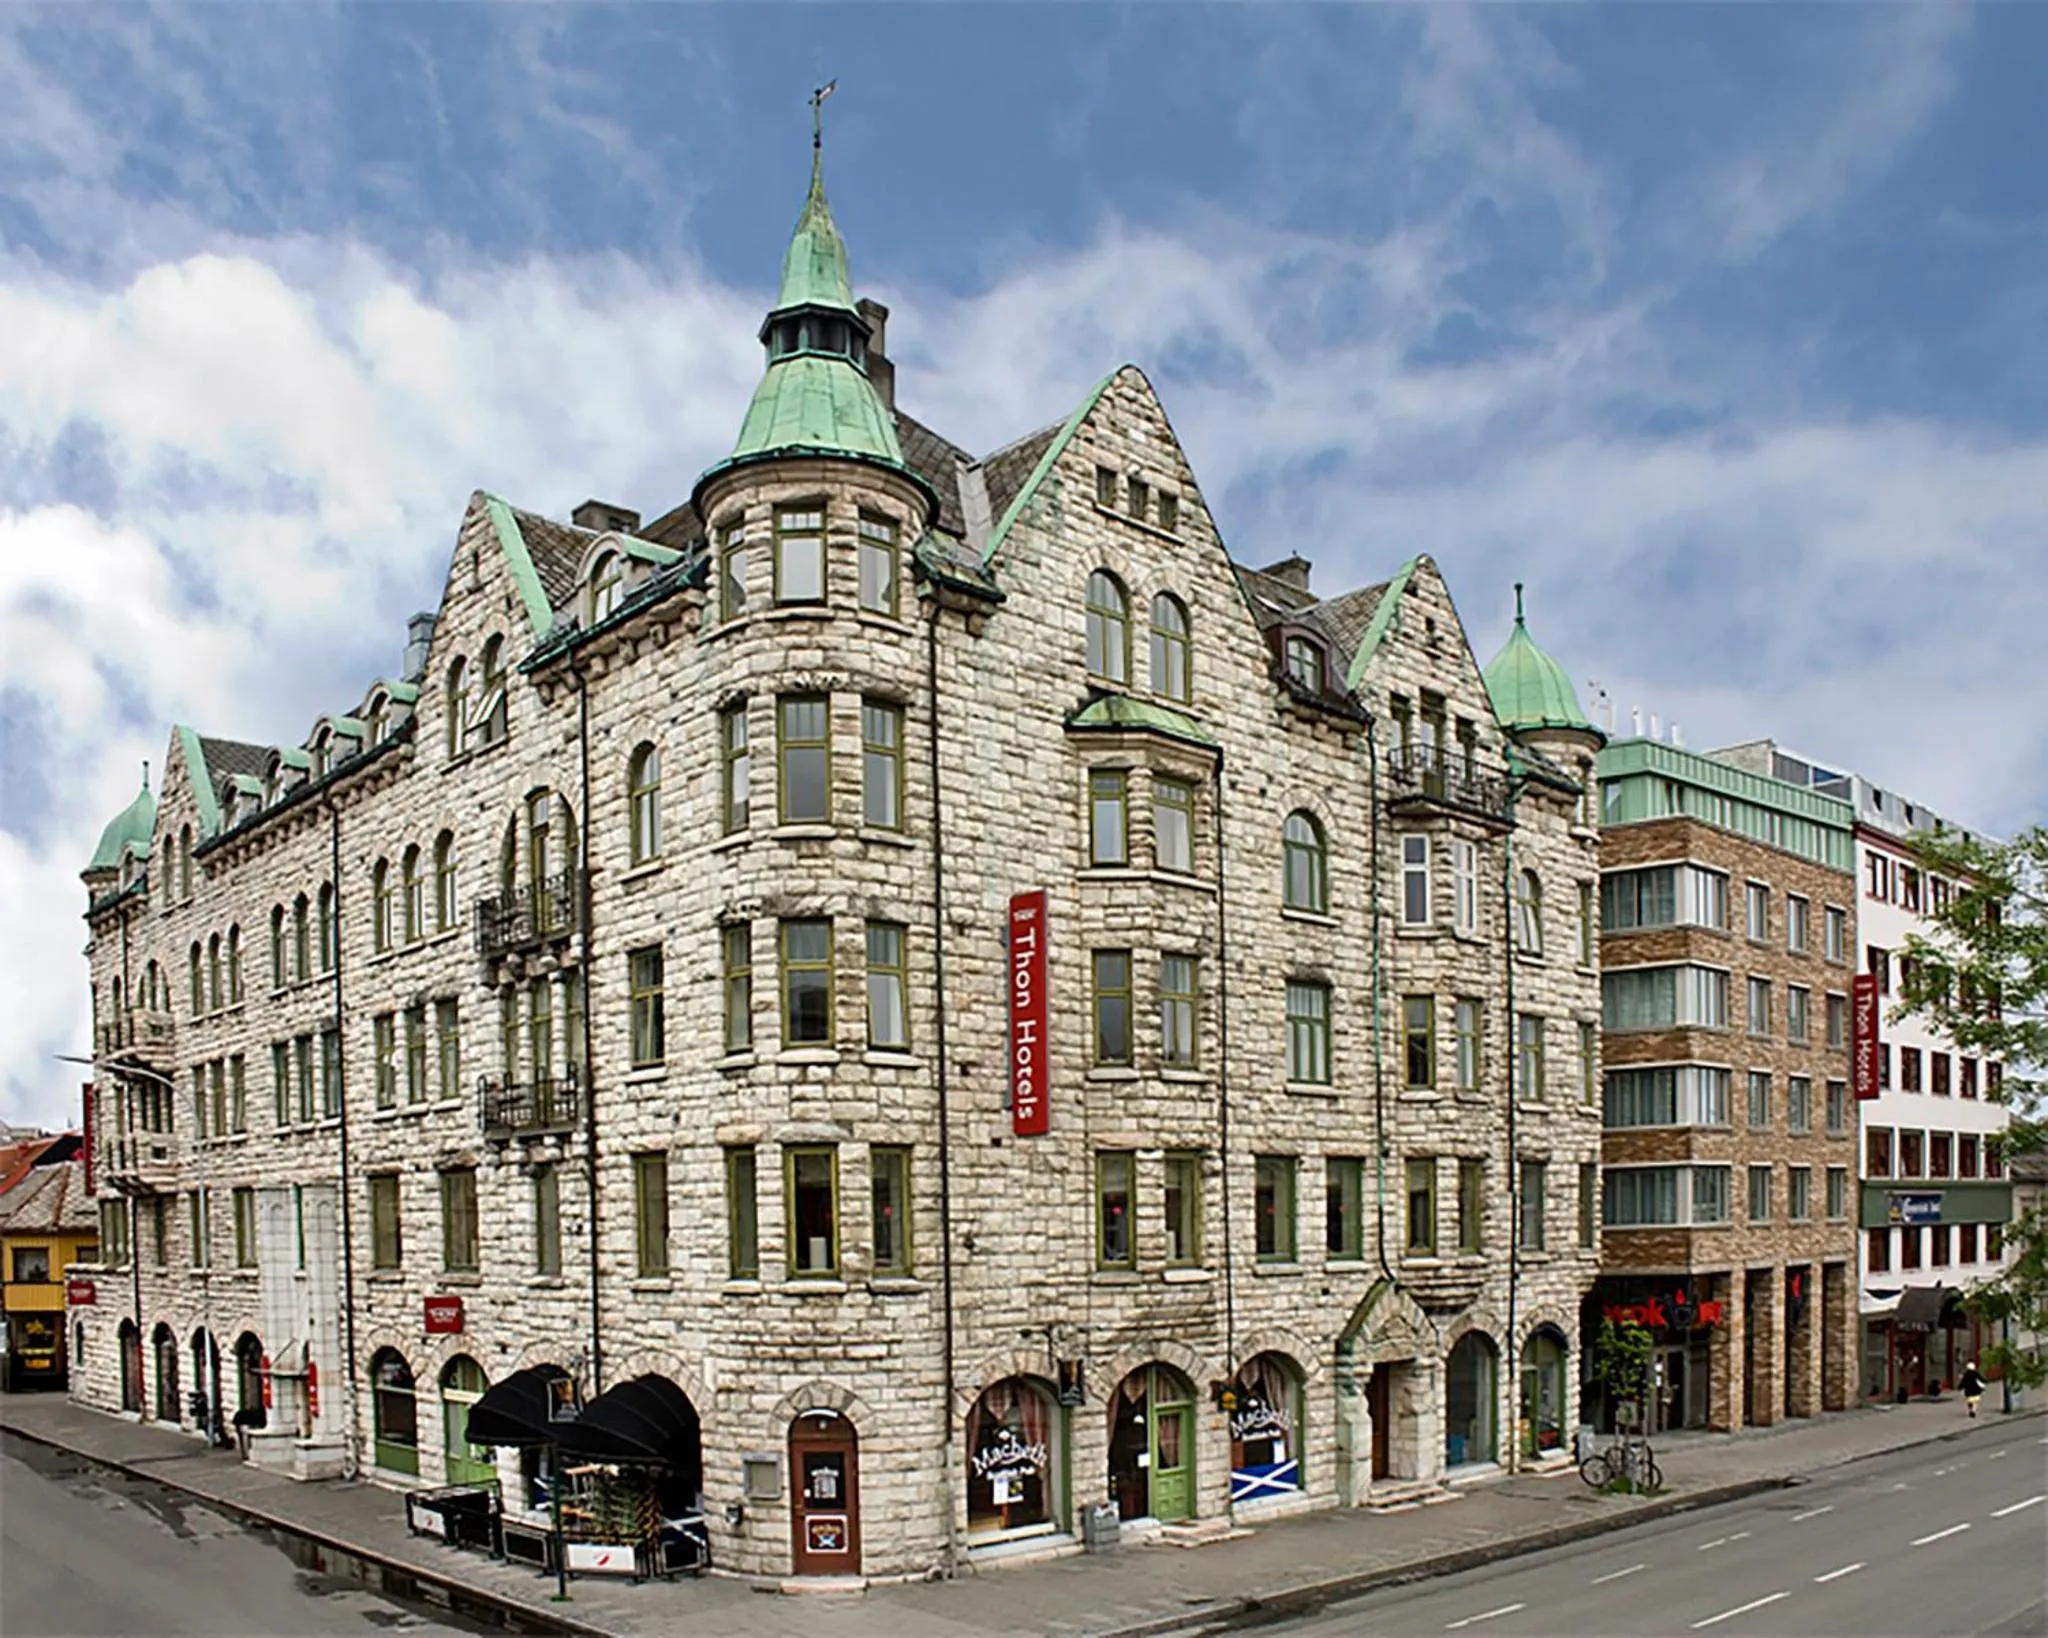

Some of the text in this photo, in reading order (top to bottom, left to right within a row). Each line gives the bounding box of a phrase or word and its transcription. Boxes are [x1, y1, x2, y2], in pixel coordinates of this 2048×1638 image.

[1015, 927, 1036, 1008] Thon
[1016, 1019, 1038, 1120] Hotels
[1857, 992, 1873, 1092] Thon Hotels
[971, 1433, 1047, 1476] Macbeth
